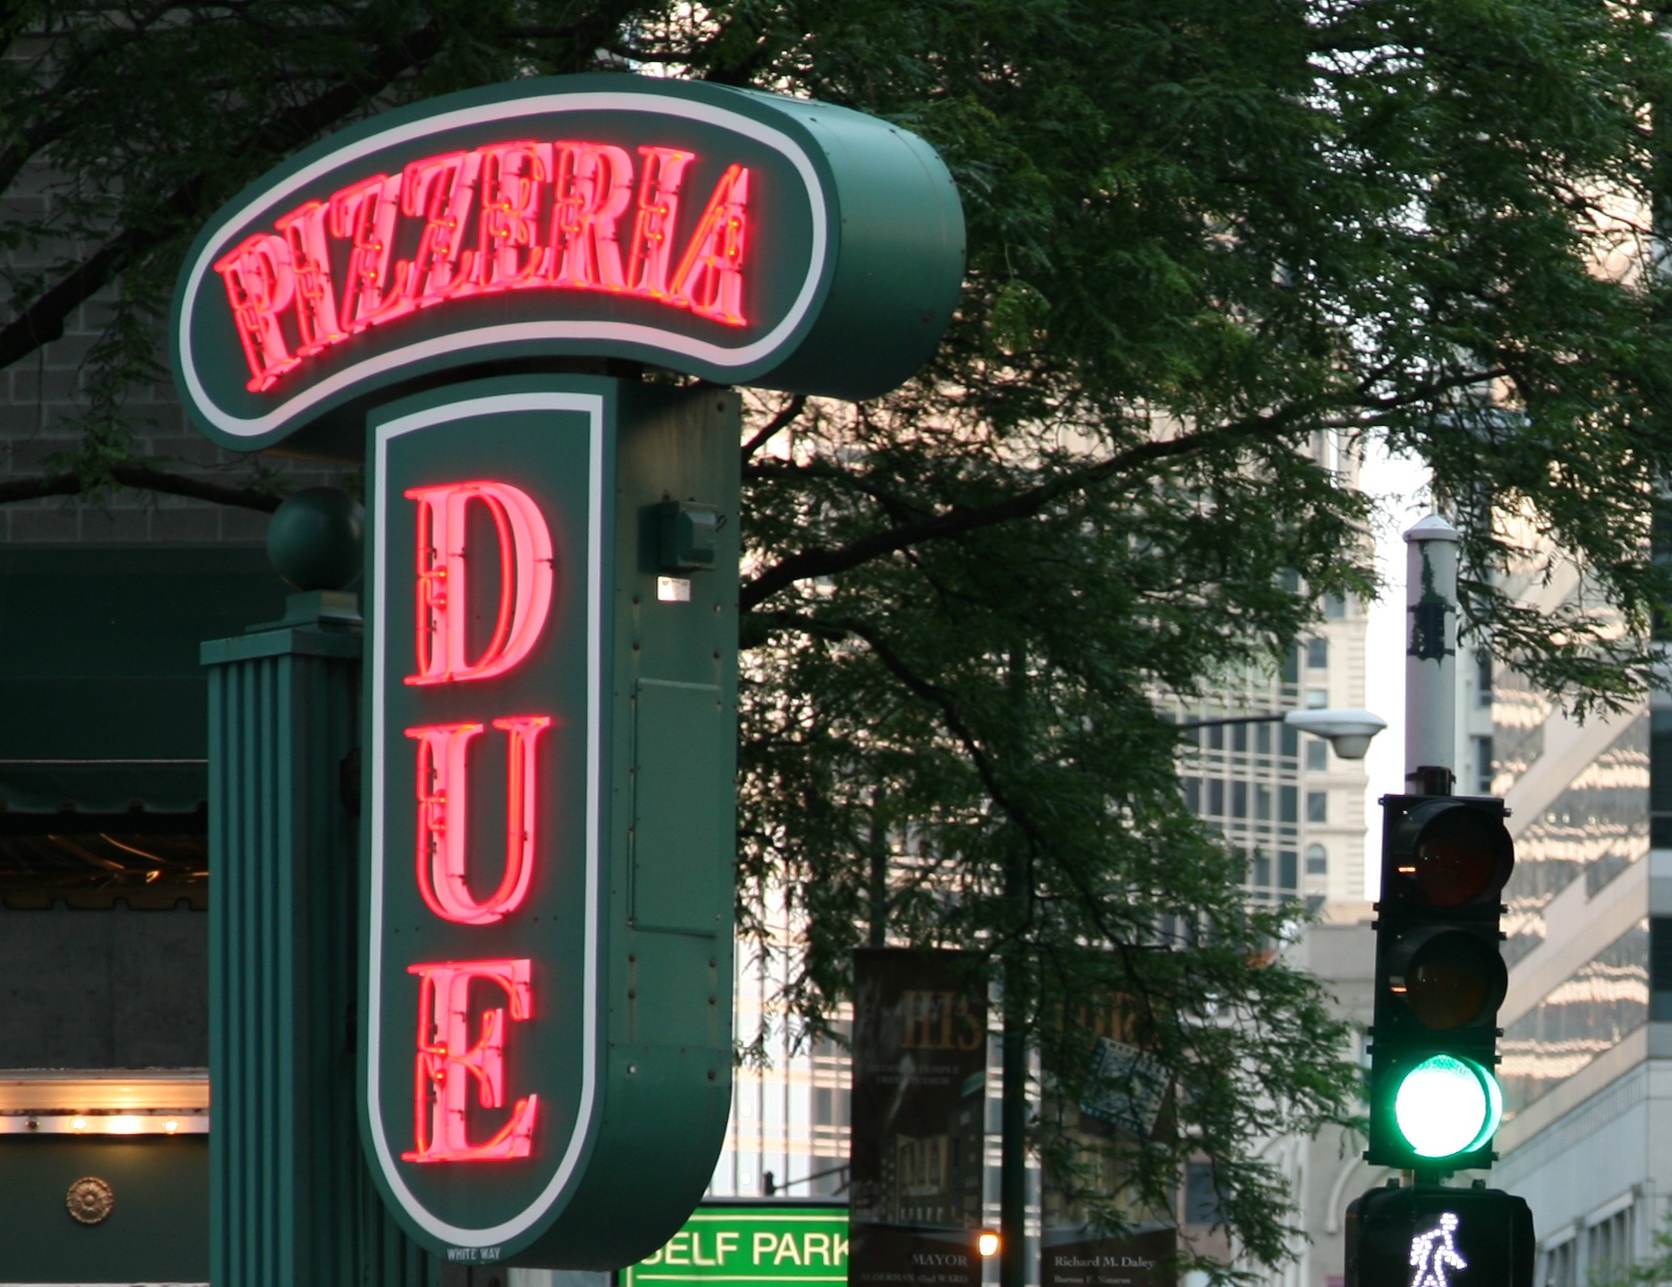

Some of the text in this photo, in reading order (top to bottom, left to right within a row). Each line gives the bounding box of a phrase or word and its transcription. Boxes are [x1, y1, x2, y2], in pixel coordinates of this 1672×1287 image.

[213, 140, 751, 394] PIZZERIA
[401, 478, 557, 1164] DUE
[446, 1246, 501, 1261] WHITE WAY
[911, 1253, 969, 1267] MAYOR
[1054, 1255, 1156, 1271] Richard M. Daley
